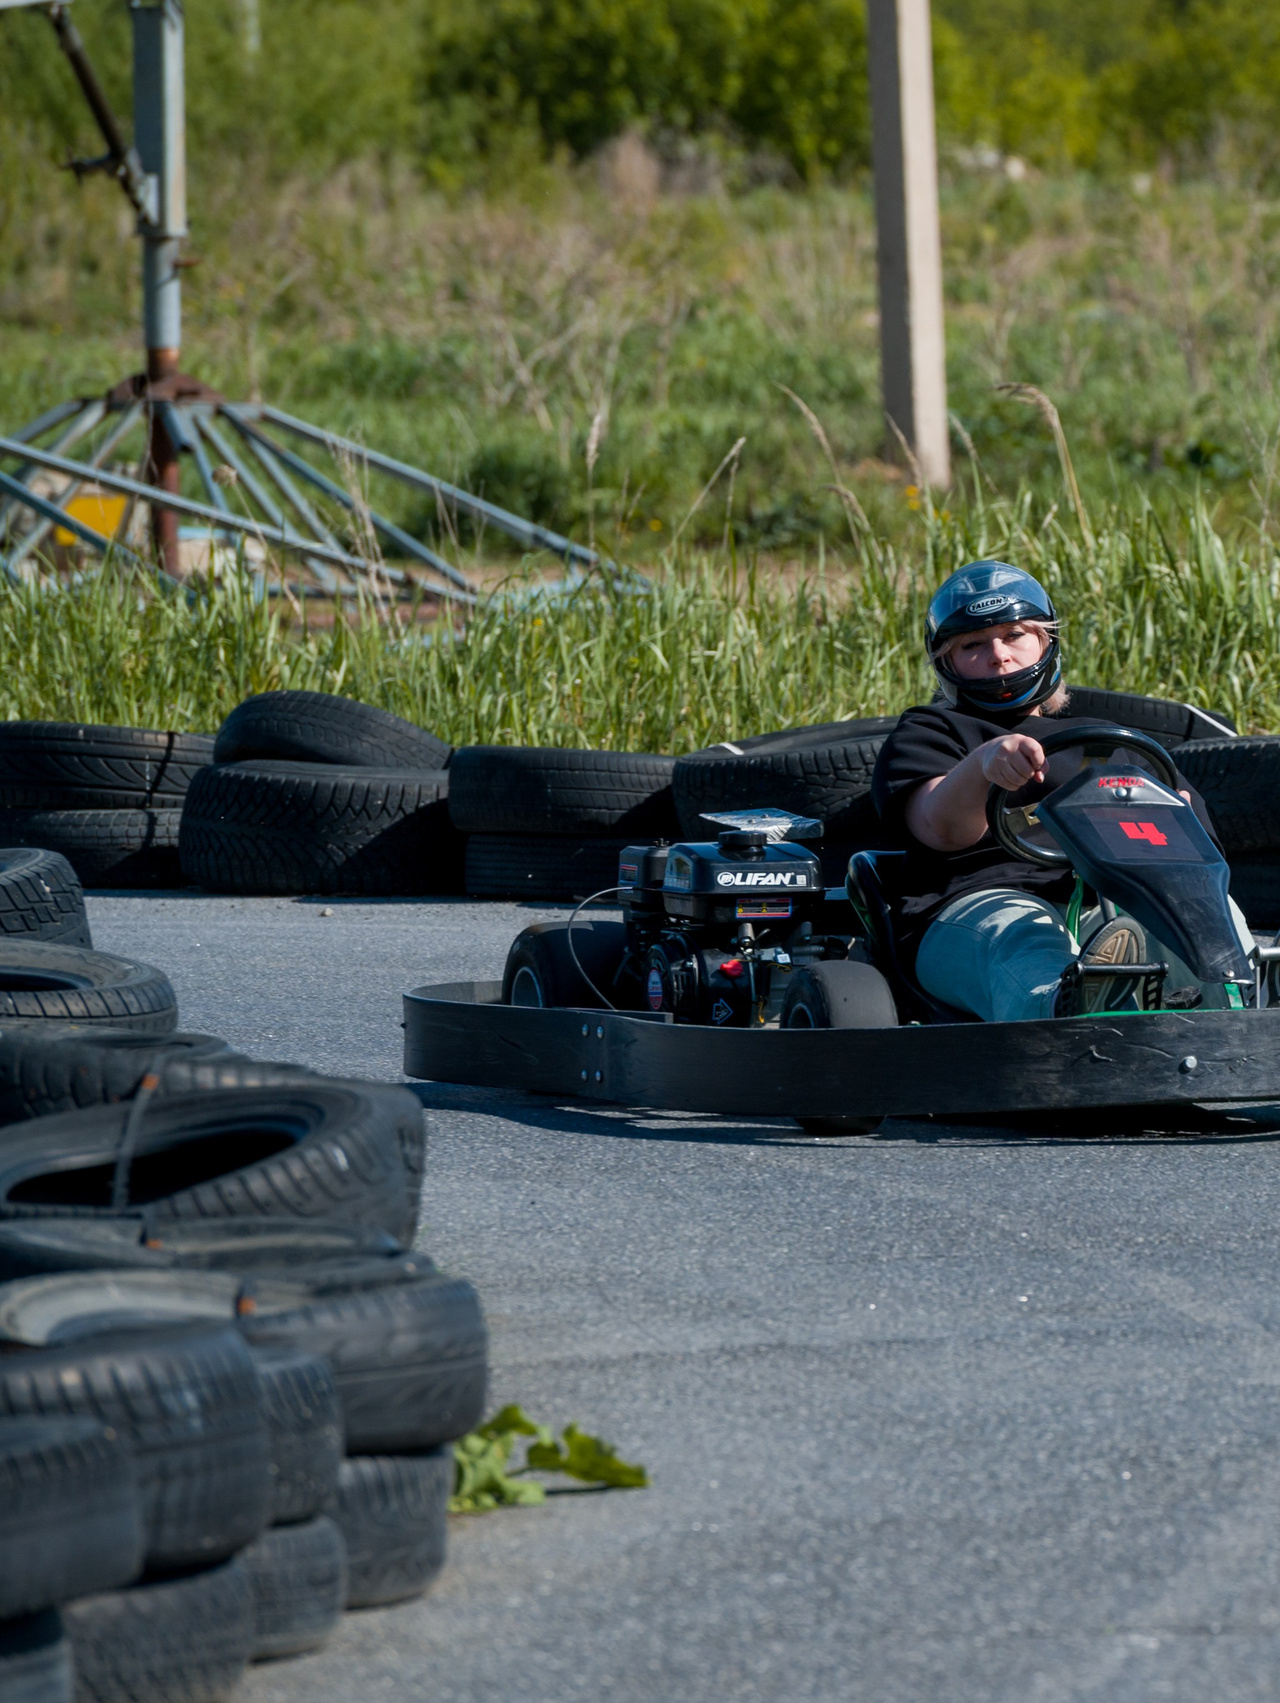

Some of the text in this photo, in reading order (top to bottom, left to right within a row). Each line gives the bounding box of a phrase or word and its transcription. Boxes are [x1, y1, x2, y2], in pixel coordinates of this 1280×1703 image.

[1098, 777, 1145, 788] KENDA
[1118, 822, 1168, 845] 4
[734, 872, 792, 886] LIFAN
